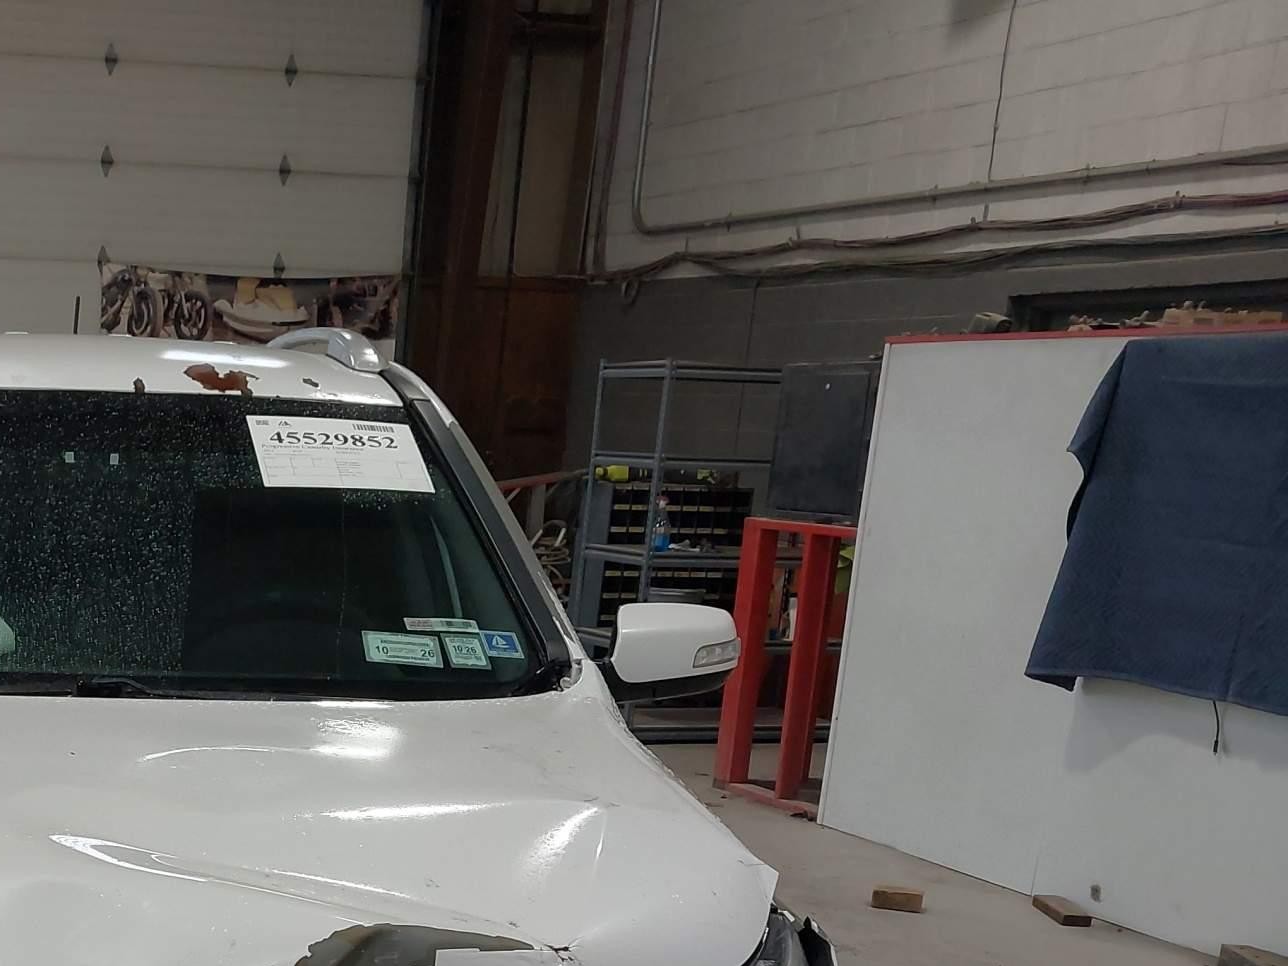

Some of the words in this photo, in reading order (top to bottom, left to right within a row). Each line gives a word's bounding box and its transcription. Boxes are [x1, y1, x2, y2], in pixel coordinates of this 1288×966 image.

[269, 431, 399, 449] 45529852
[375, 645, 389, 655] 10
[420, 649, 435, 658] 26
